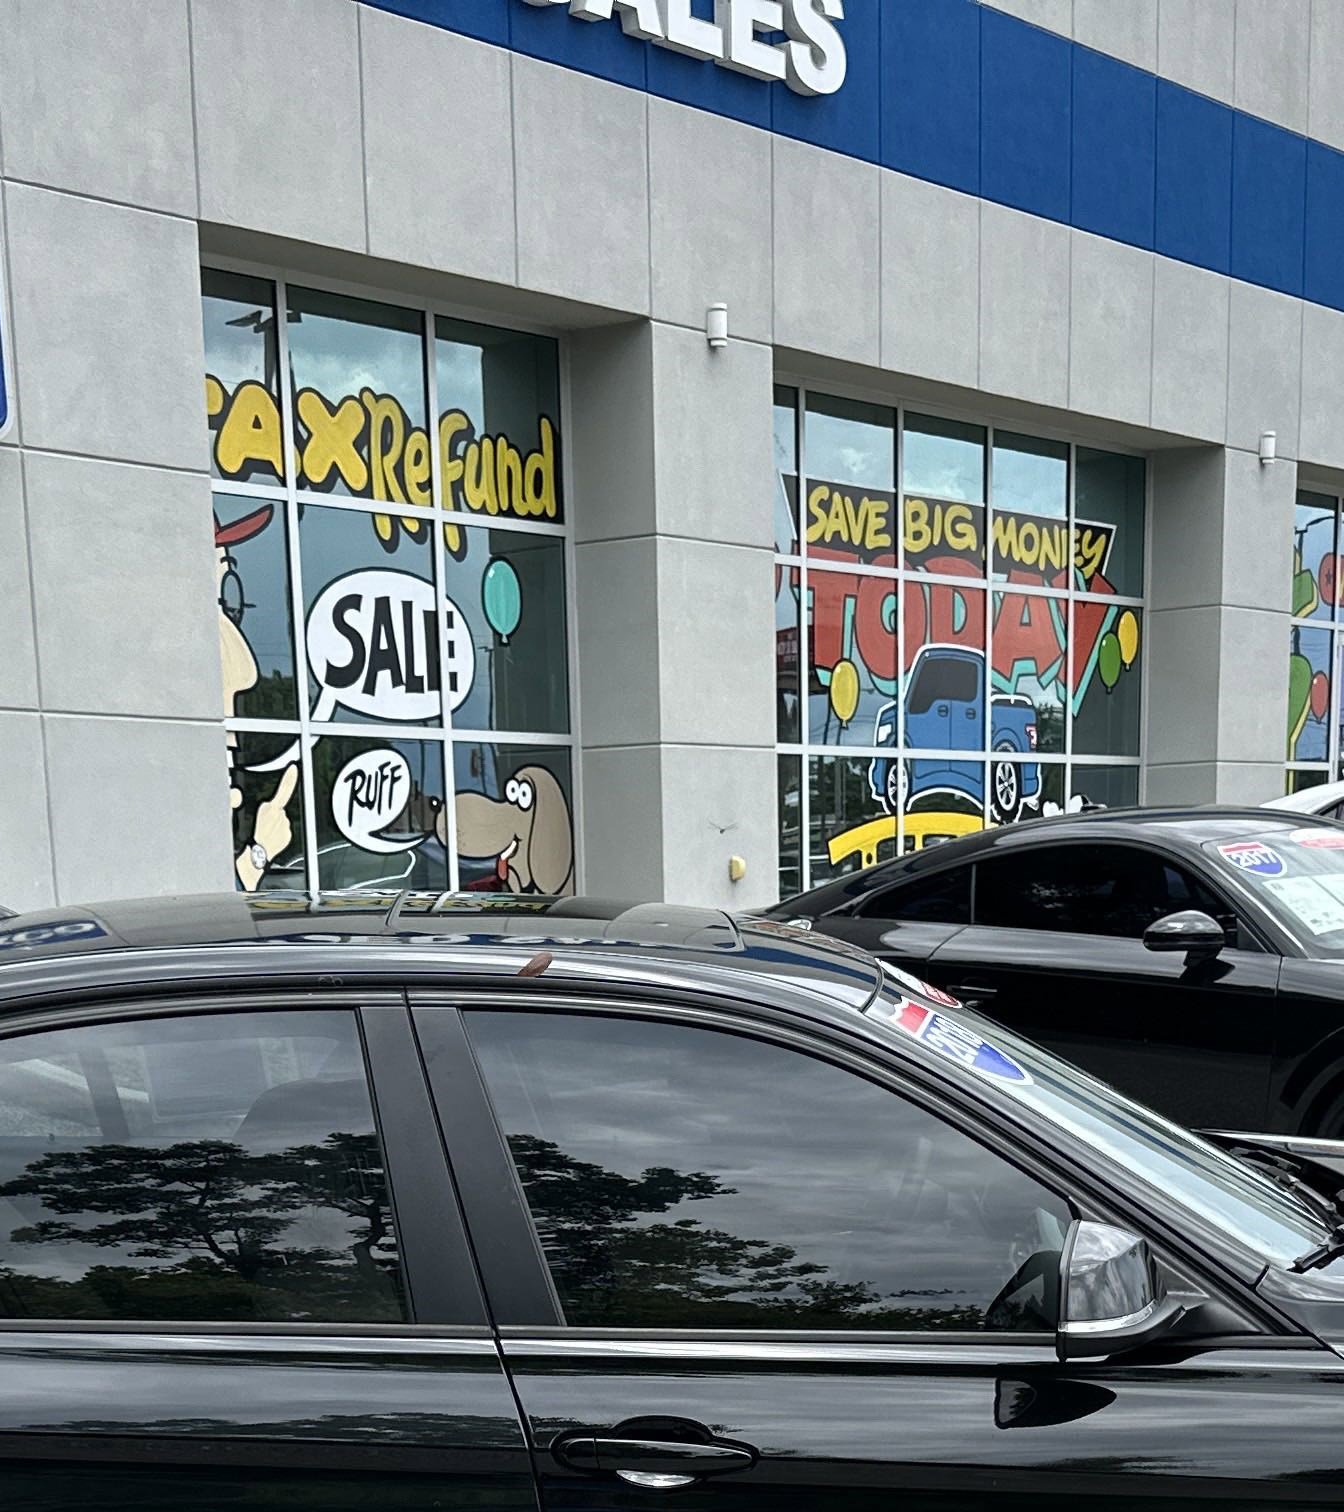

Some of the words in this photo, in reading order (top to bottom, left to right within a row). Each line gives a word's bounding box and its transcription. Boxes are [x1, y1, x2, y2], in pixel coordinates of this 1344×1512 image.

[526, 0, 848, 95] LES
[359, 387, 558, 552] Refund
[807, 484, 893, 550] SAVE
[903, 499, 978, 553] BIG
[981, 515, 1107, 579] MONEY
[325, 594, 458, 696] SALE
[791, 543, 1118, 704] TODAY
[343, 762, 403, 826] RUFF
[1233, 851, 1278, 868] 2017
